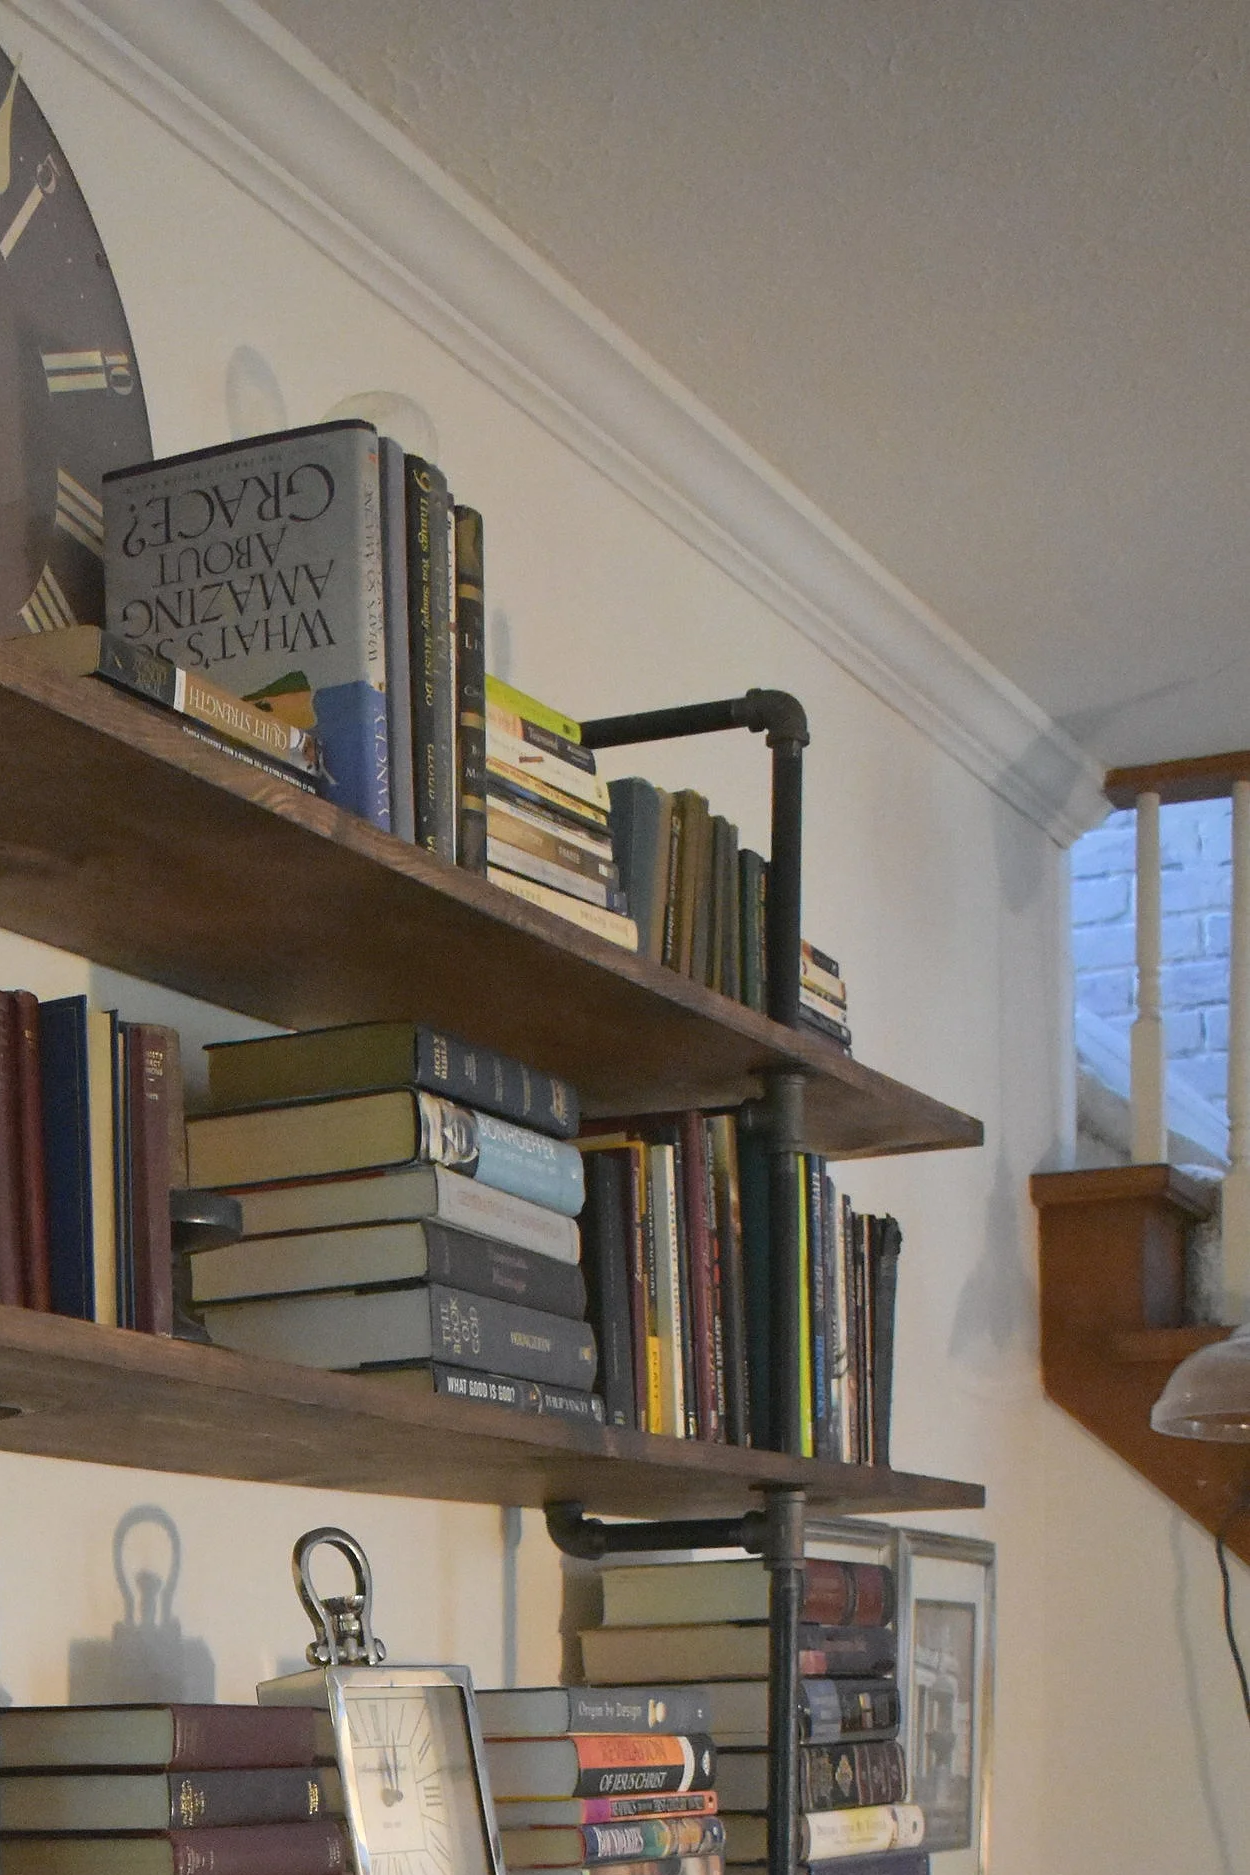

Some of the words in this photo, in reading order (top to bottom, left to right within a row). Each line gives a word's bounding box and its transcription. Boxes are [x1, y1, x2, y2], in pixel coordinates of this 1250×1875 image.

[121, 462, 336, 559] GRACE?
[152, 525, 288, 588] ABOUT
[121, 558, 336, 640] AMAZING
[186, 607, 337, 670] WHAT'S
[187, 684, 252, 732] STRENGTH
[252, 715, 288, 751] QUIET
[373, 709, 391, 818] YANCEY
[599, 1774, 614, 1792] OF
[634, 1771, 668, 1790] CHRIST
